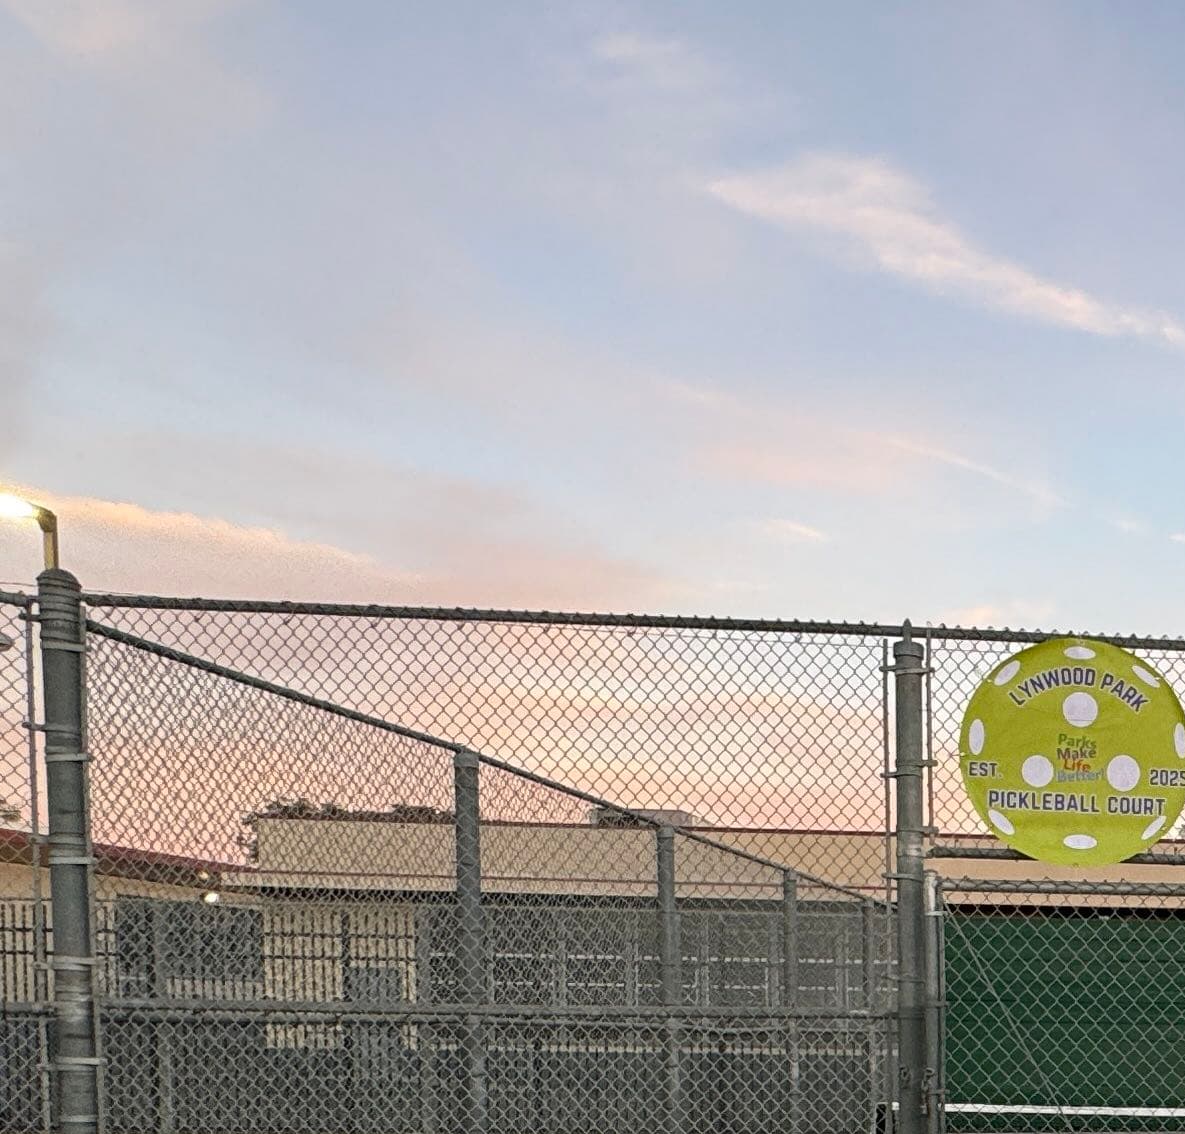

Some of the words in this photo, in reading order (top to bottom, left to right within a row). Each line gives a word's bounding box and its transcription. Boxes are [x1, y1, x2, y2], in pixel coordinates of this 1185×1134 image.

[1008, 667, 1096, 707] LYNWOOD
[1100, 673, 1149, 714] PARK
[1057, 733, 1097, 750] Parks
[1057, 748, 1097, 762] Make
[968, 761, 1003, 778] EST.
[1063, 759, 1091, 771] Life
[1056, 768, 1105, 783] Better!
[988, 790, 1100, 813] PICKLEBALL
[1107, 796, 1166, 816] COURT
